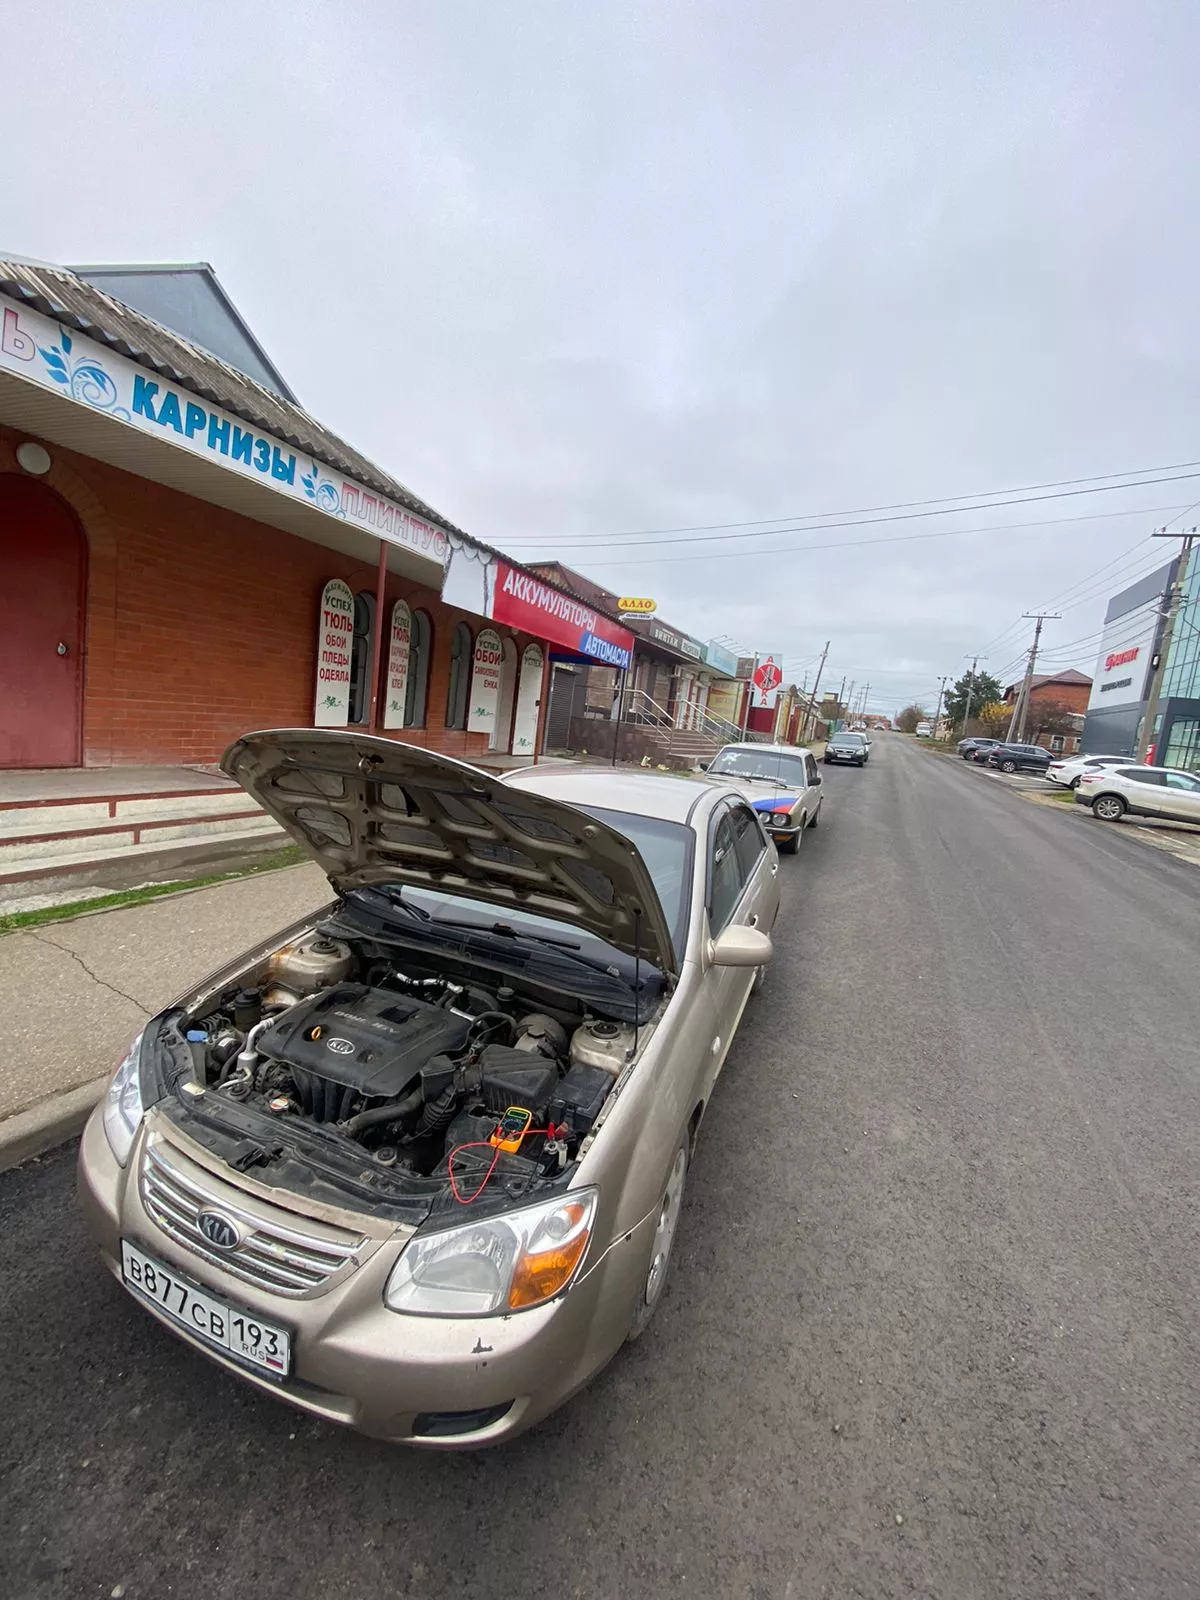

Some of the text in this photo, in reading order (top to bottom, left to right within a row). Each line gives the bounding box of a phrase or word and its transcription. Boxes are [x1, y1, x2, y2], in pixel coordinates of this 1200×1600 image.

[132, 374, 297, 486] КАРНИЗЫ
[325, 596, 352, 613] УСПЕХ
[502, 568, 597, 632] АККУМУЛЯТОРЫ
[620, 599, 652, 609] АЛЛО
[324, 610, 353, 633] ТЮЛЬ
[325, 634, 347, 649] ОБОИ
[392, 626, 410, 643] ТЮЛЬ
[478, 641, 500, 652] УСПЕХ
[584, 634, 630, 669] АВТОМАСЛА
[322, 650, 350, 667] ПЛЕДЫ
[475, 648, 502, 666] ОБОИ
[319, 668, 349, 682] ОДЕЯЛА
[329, 1040, 350, 1053] KIA
[202, 1215, 231, 1247] KIA
[233, 1317, 279, 1356] 193
[241, 1342, 266, 1361] RUS
